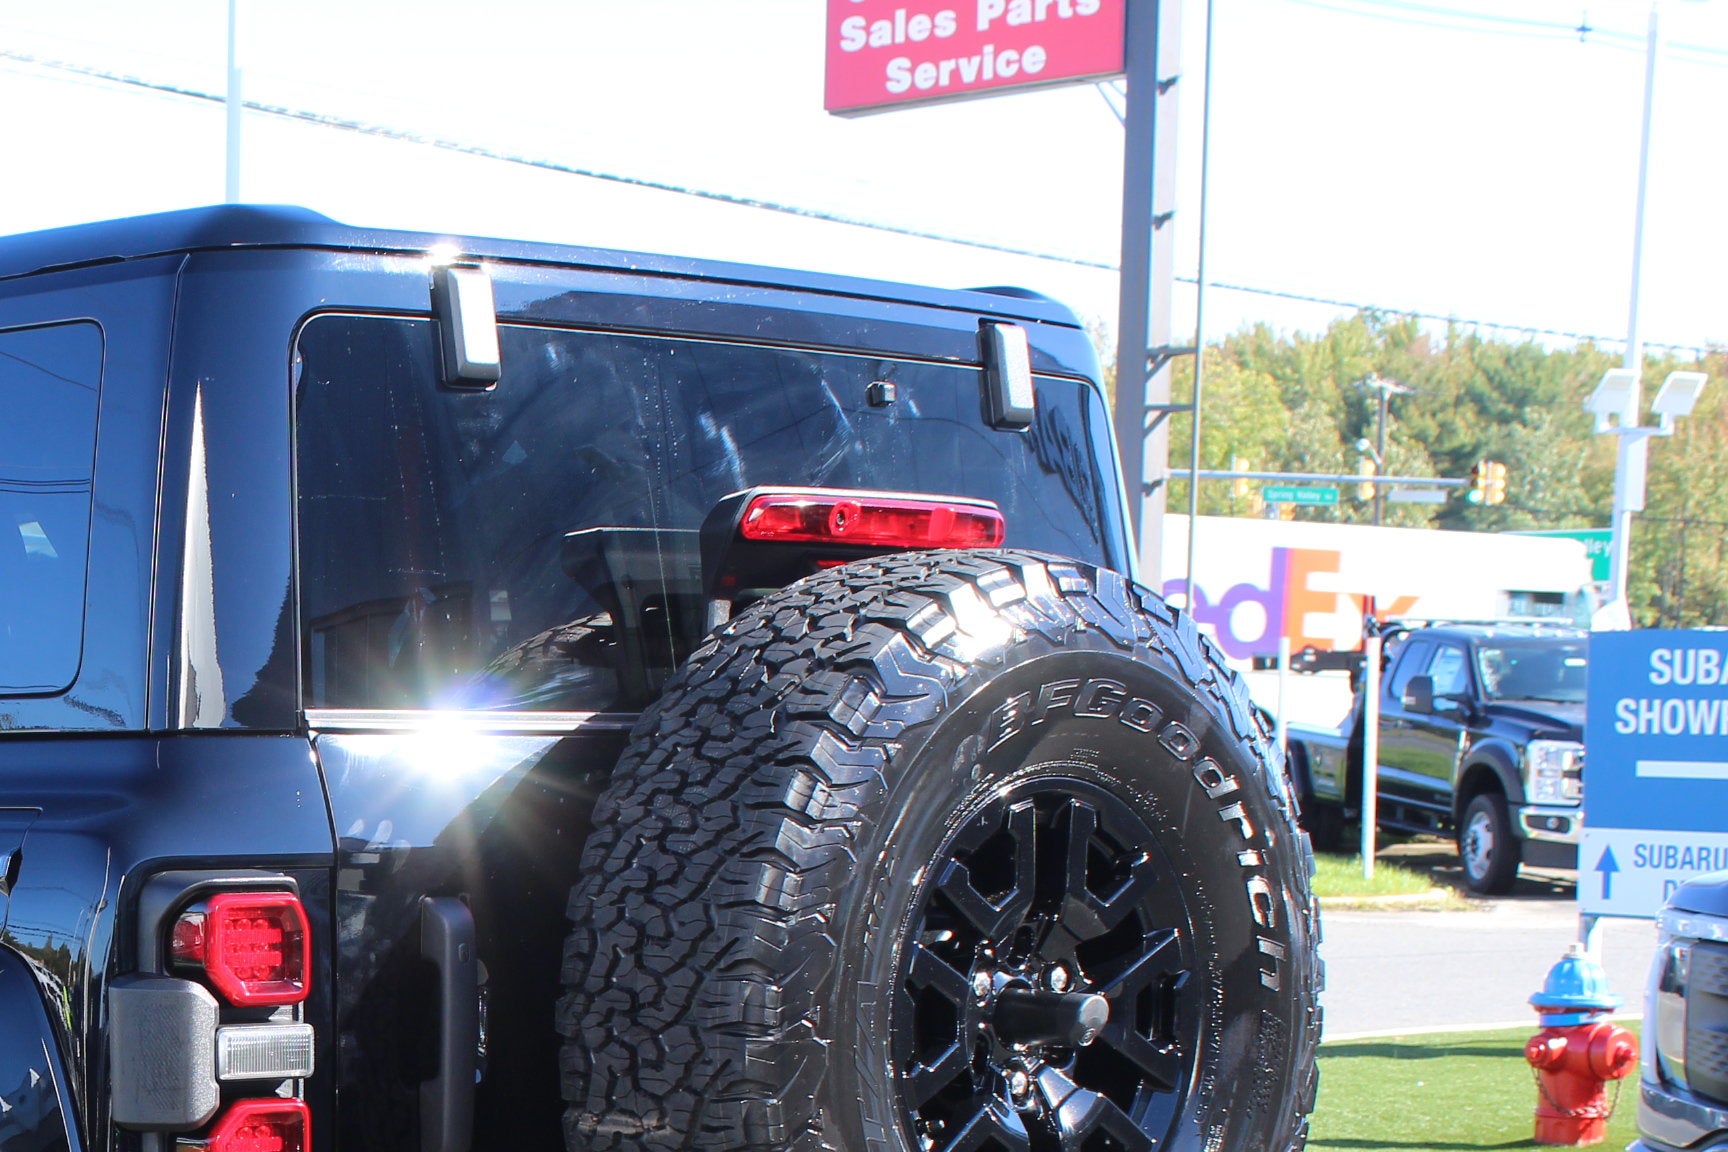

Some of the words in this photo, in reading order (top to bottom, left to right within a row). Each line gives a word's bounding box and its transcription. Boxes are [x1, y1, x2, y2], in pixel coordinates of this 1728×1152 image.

[840, 8, 957, 52] Sales
[976, 0, 1101, 31] Parts
[885, 44, 1047, 94] Service
[1583, 537, 1612, 558] lley
[984, 678, 1287, 992] BFGoodrich
[1633, 843, 1728, 871] SUBARU
